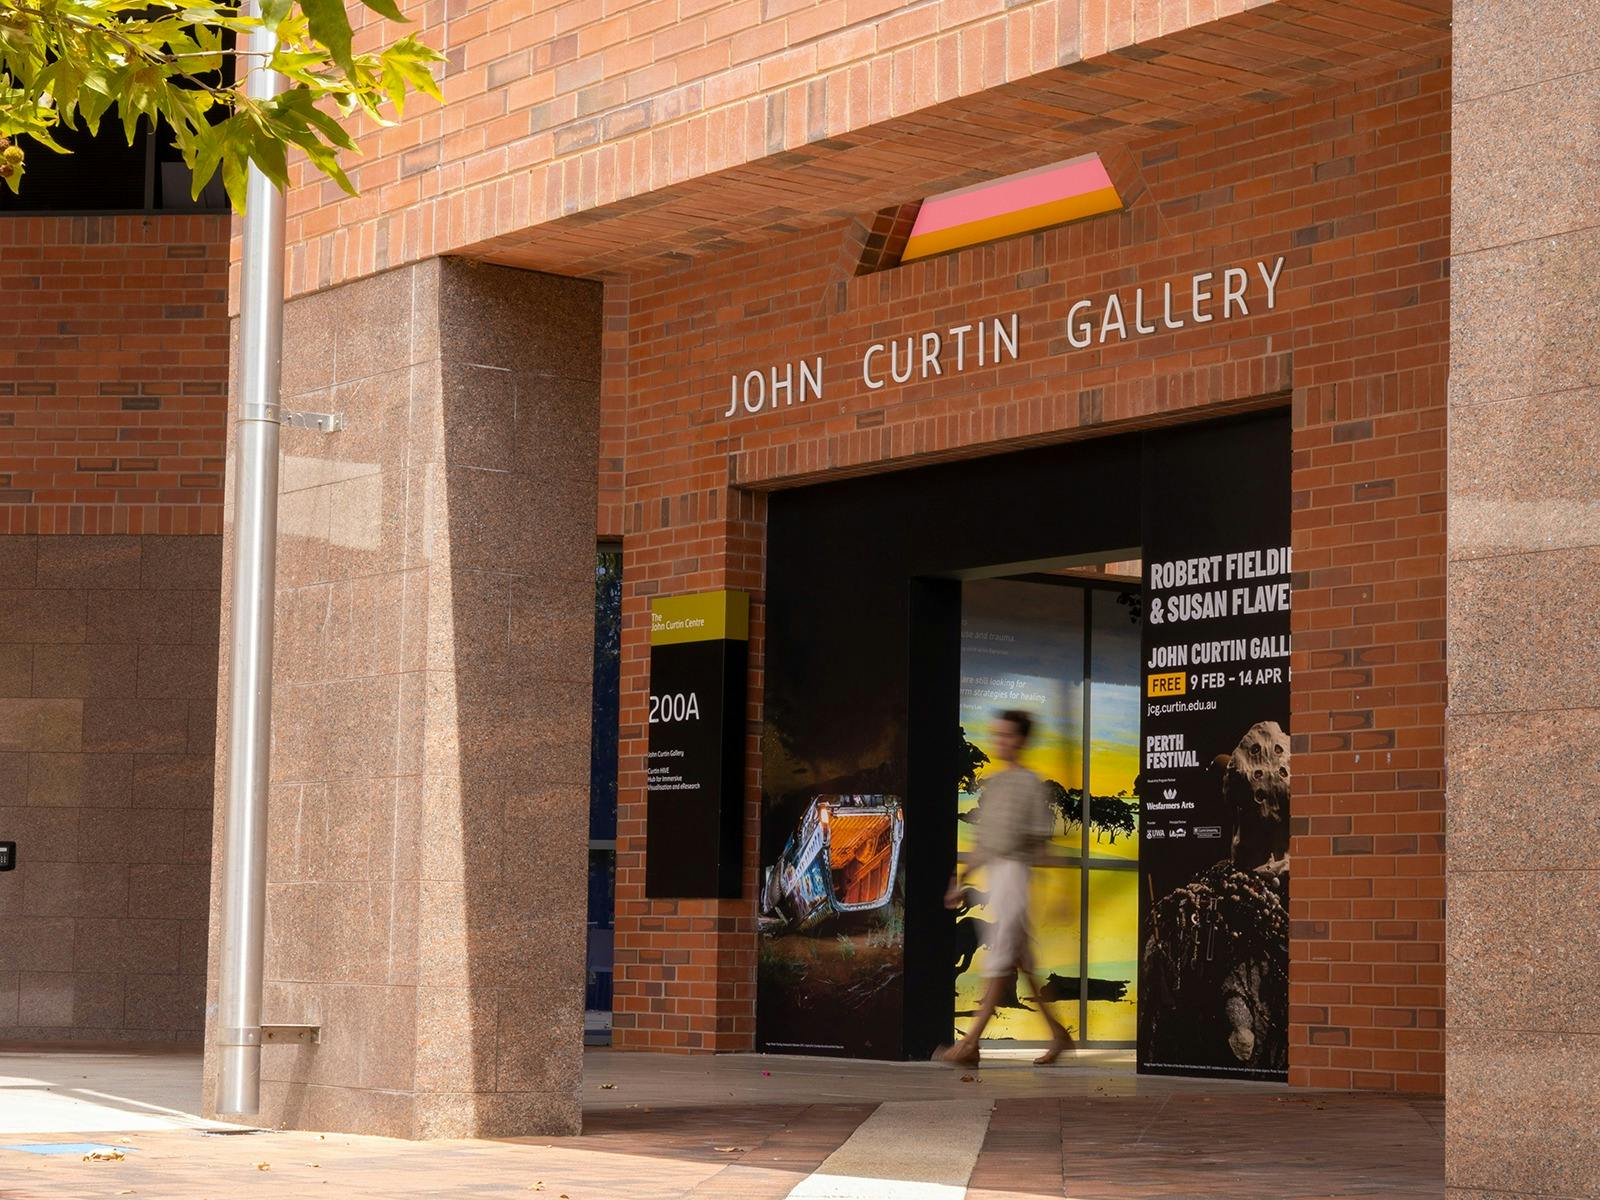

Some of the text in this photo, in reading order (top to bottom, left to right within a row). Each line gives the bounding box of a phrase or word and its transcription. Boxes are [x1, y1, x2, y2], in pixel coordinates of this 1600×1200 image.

[724, 256, 1285, 418] JOHN CURTIN GALLERY
[1150, 554, 1223, 591] ROBERT
[1149, 583, 1292, 625] & SUSAN FLAVE
[651, 613, 662, 622] The
[651, 618, 705, 632] John Curtin Centre
[1147, 634, 1292, 669] JOHN CURTIN GALL
[989, 676, 1015, 690] looking
[1015, 679, 1026, 688] for
[1152, 677, 1182, 692] FREE
[1190, 674, 1199, 691] 9
[1201, 672, 1226, 689] FEB
[1238, 669, 1253, 687] 14
[1255, 667, 1282, 685] APR
[1009, 690, 1021, 699] for
[648, 692, 700, 724] 200A
[1147, 700, 1217, 717] jcg.curtin.edu.au
[1146, 734, 1184, 753] PERTH
[657, 750, 670, 758] Curtin
[670, 749, 684, 758] Gallery
[1146, 750, 1200, 770] FESTIVAL
[1146, 800, 1195, 811] Wesfarmers Arts
